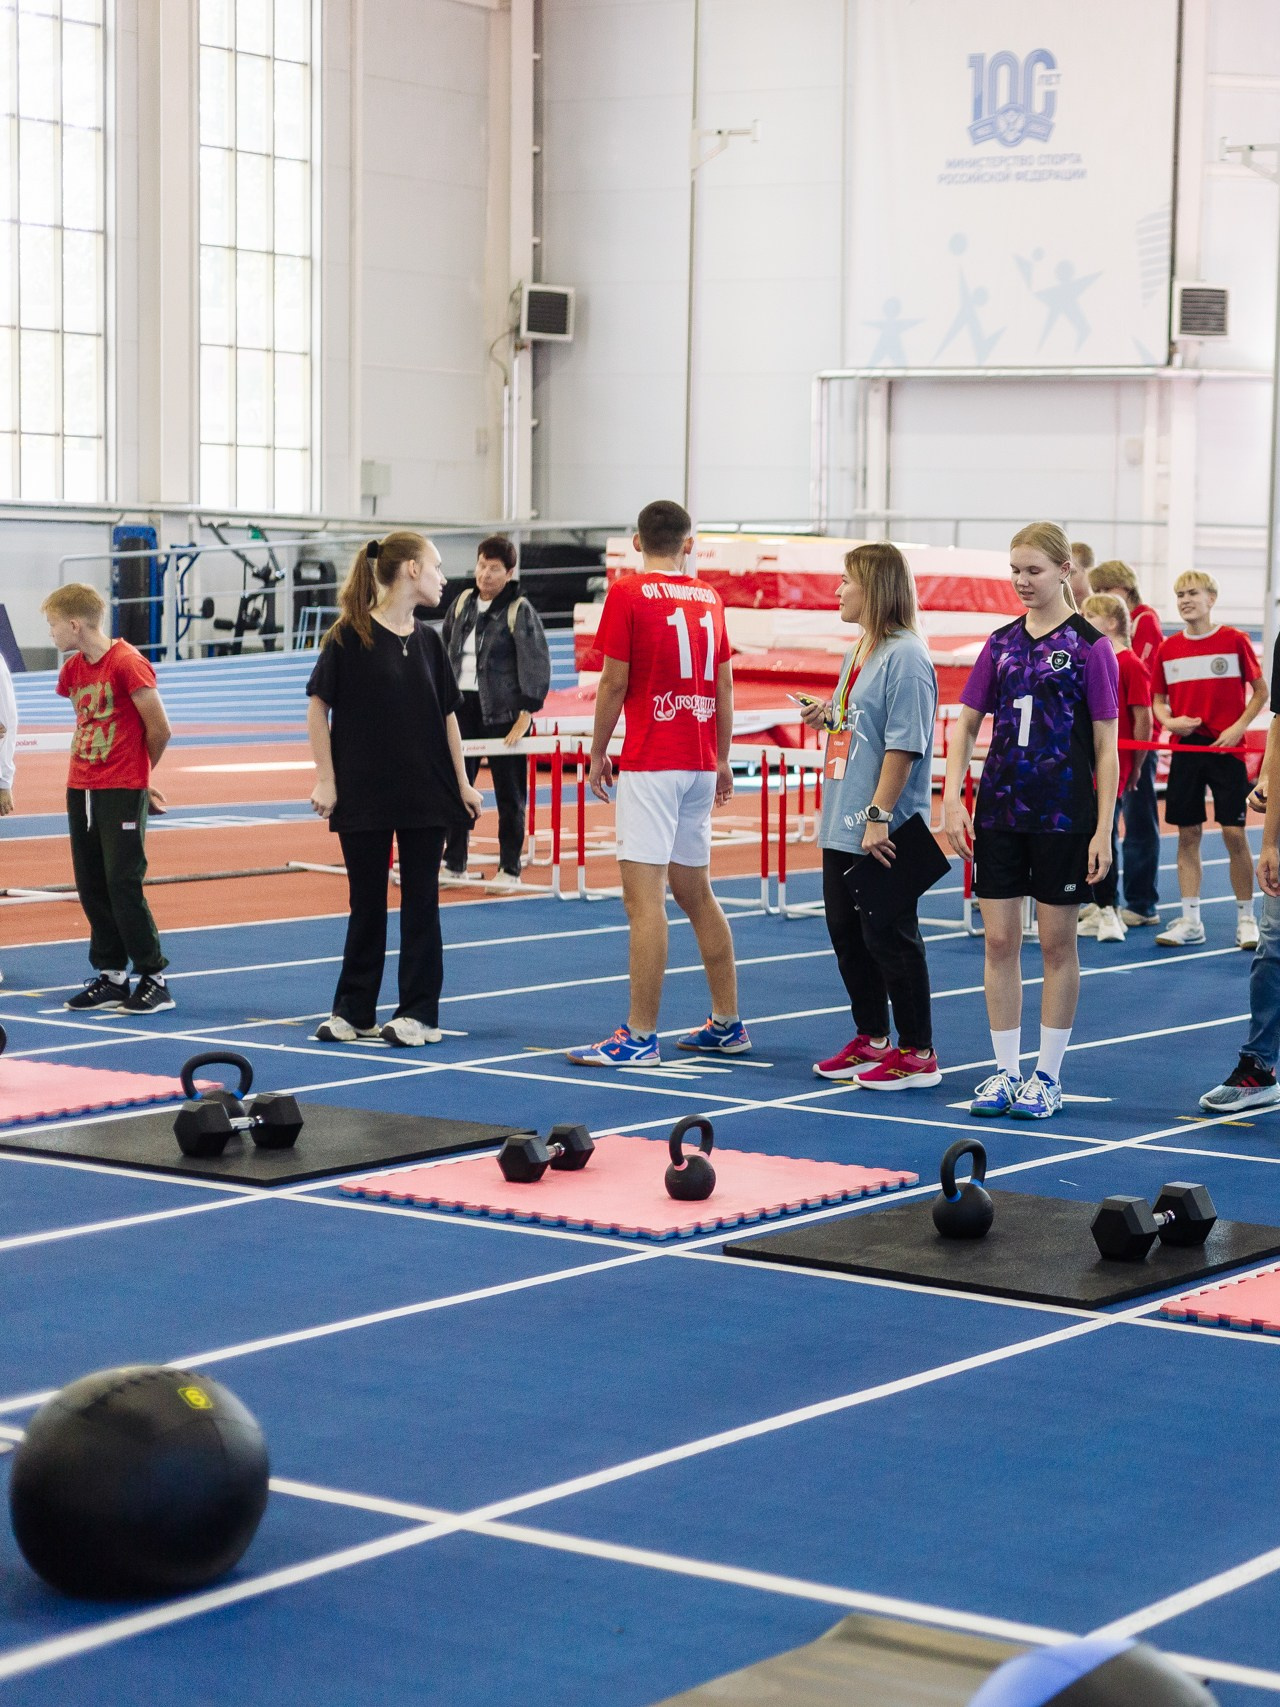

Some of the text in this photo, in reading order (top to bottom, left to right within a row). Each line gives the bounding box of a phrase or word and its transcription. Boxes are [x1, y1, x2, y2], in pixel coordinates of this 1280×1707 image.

[641, 582, 663, 600] ФК
[667, 607, 715, 682] 11
[1013, 695, 1034, 747] 1
